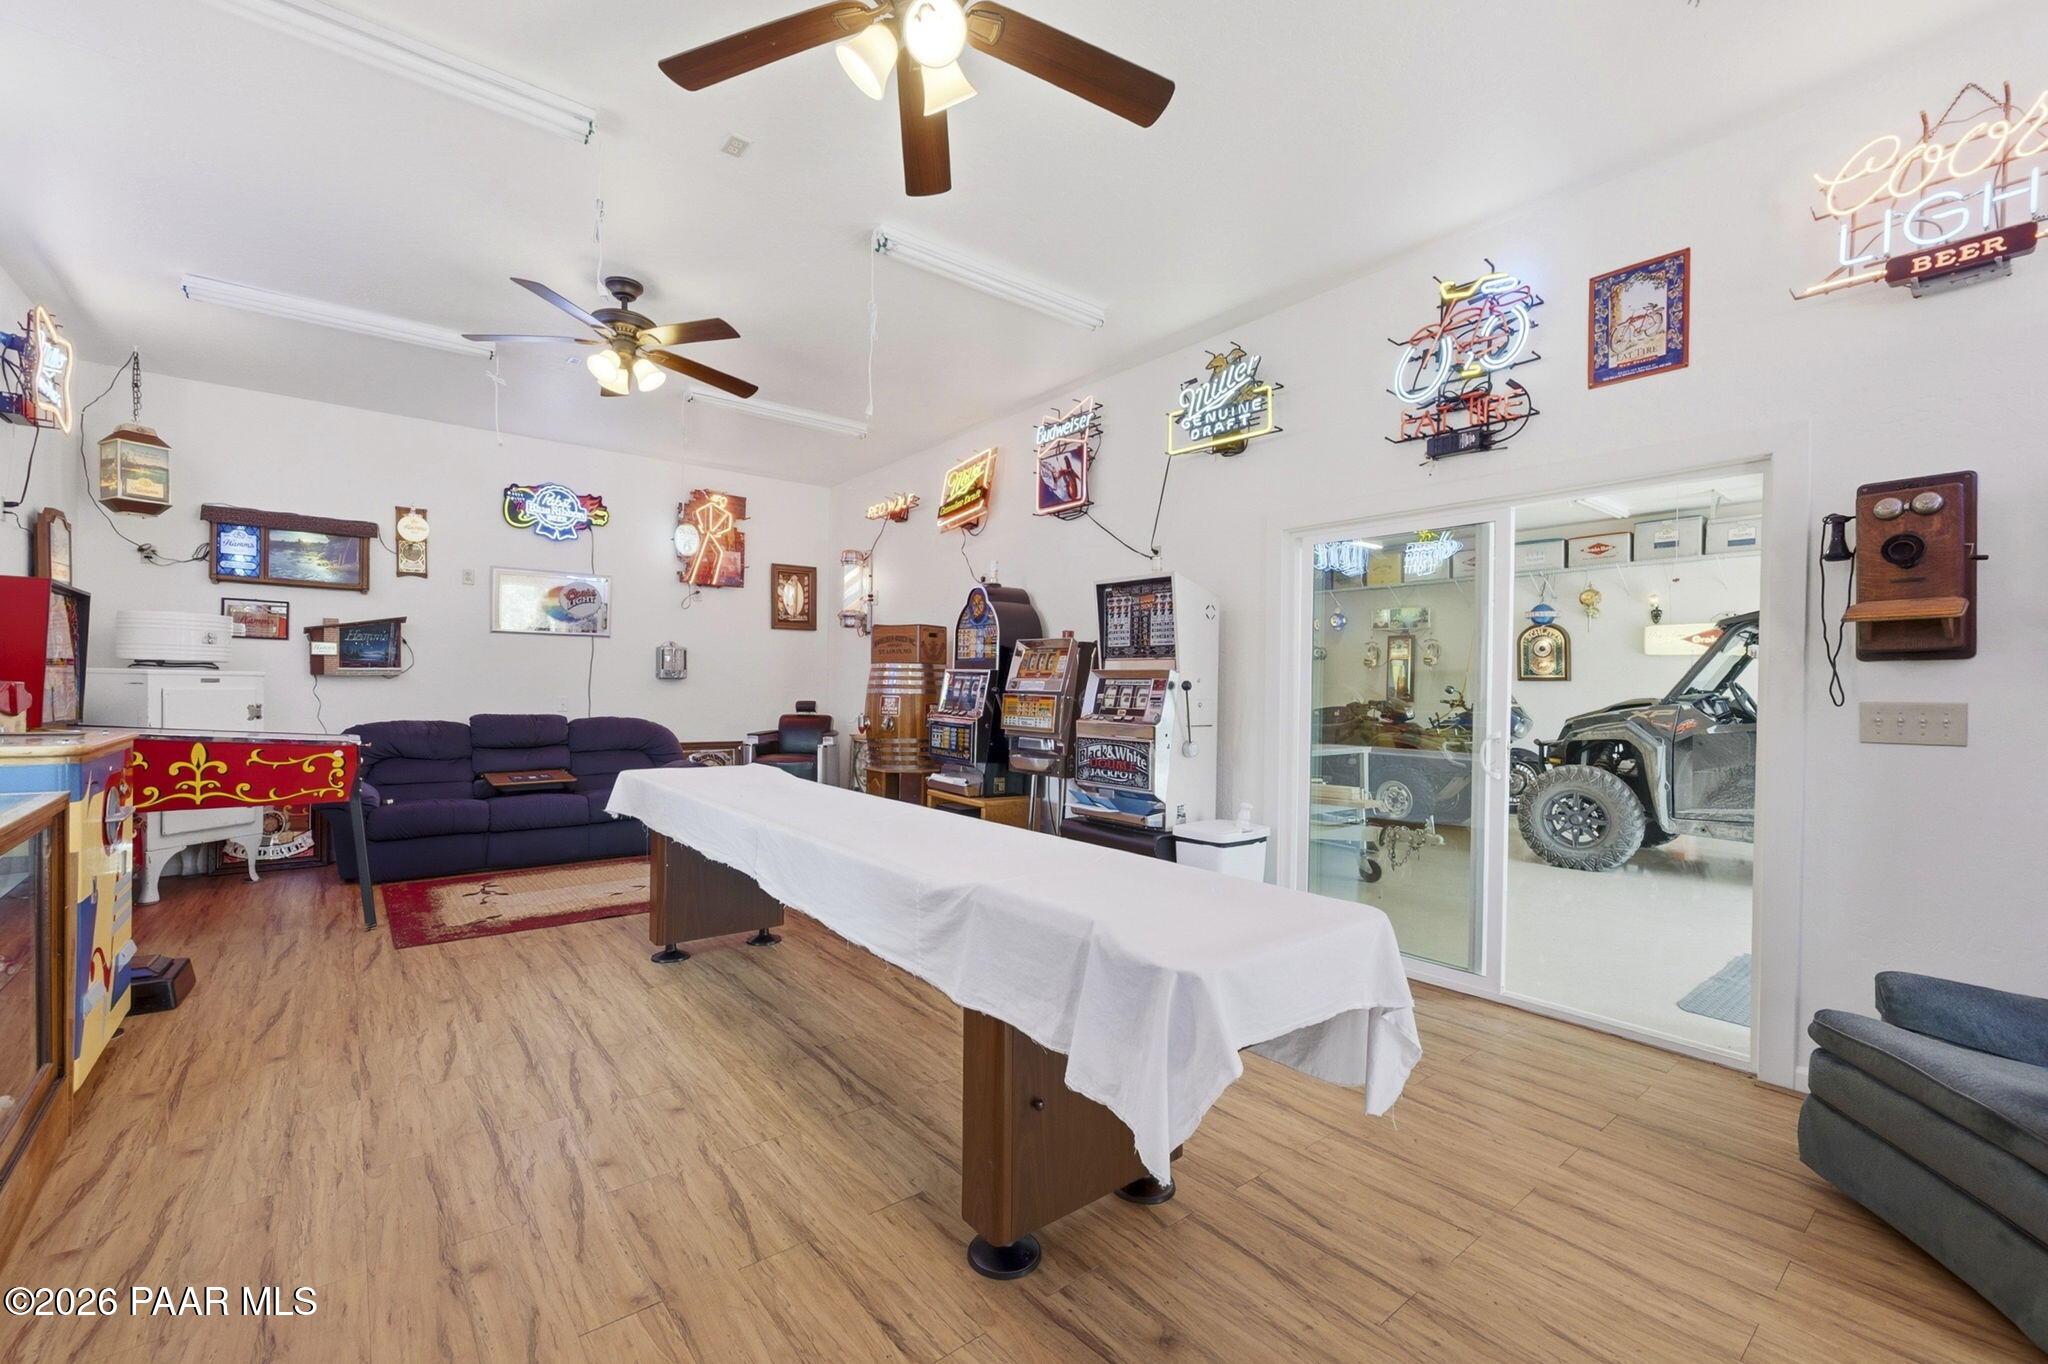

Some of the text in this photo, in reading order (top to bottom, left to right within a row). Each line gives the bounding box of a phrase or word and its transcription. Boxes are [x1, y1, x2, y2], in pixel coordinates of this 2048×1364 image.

[1839, 166, 2042, 266] LIGH
[1910, 235, 2008, 274] BEER
[1180, 354, 1260, 420] Miller
[1036, 411, 1095, 445] Budweiser
[1181, 397, 1262, 430] GENUINE
[1190, 413, 1251, 441] DRAFT
[1400, 402, 1456, 440] FAT
[1627, 709, 1677, 721] XP
[1090, 767, 1133, 780] JACKPOT
